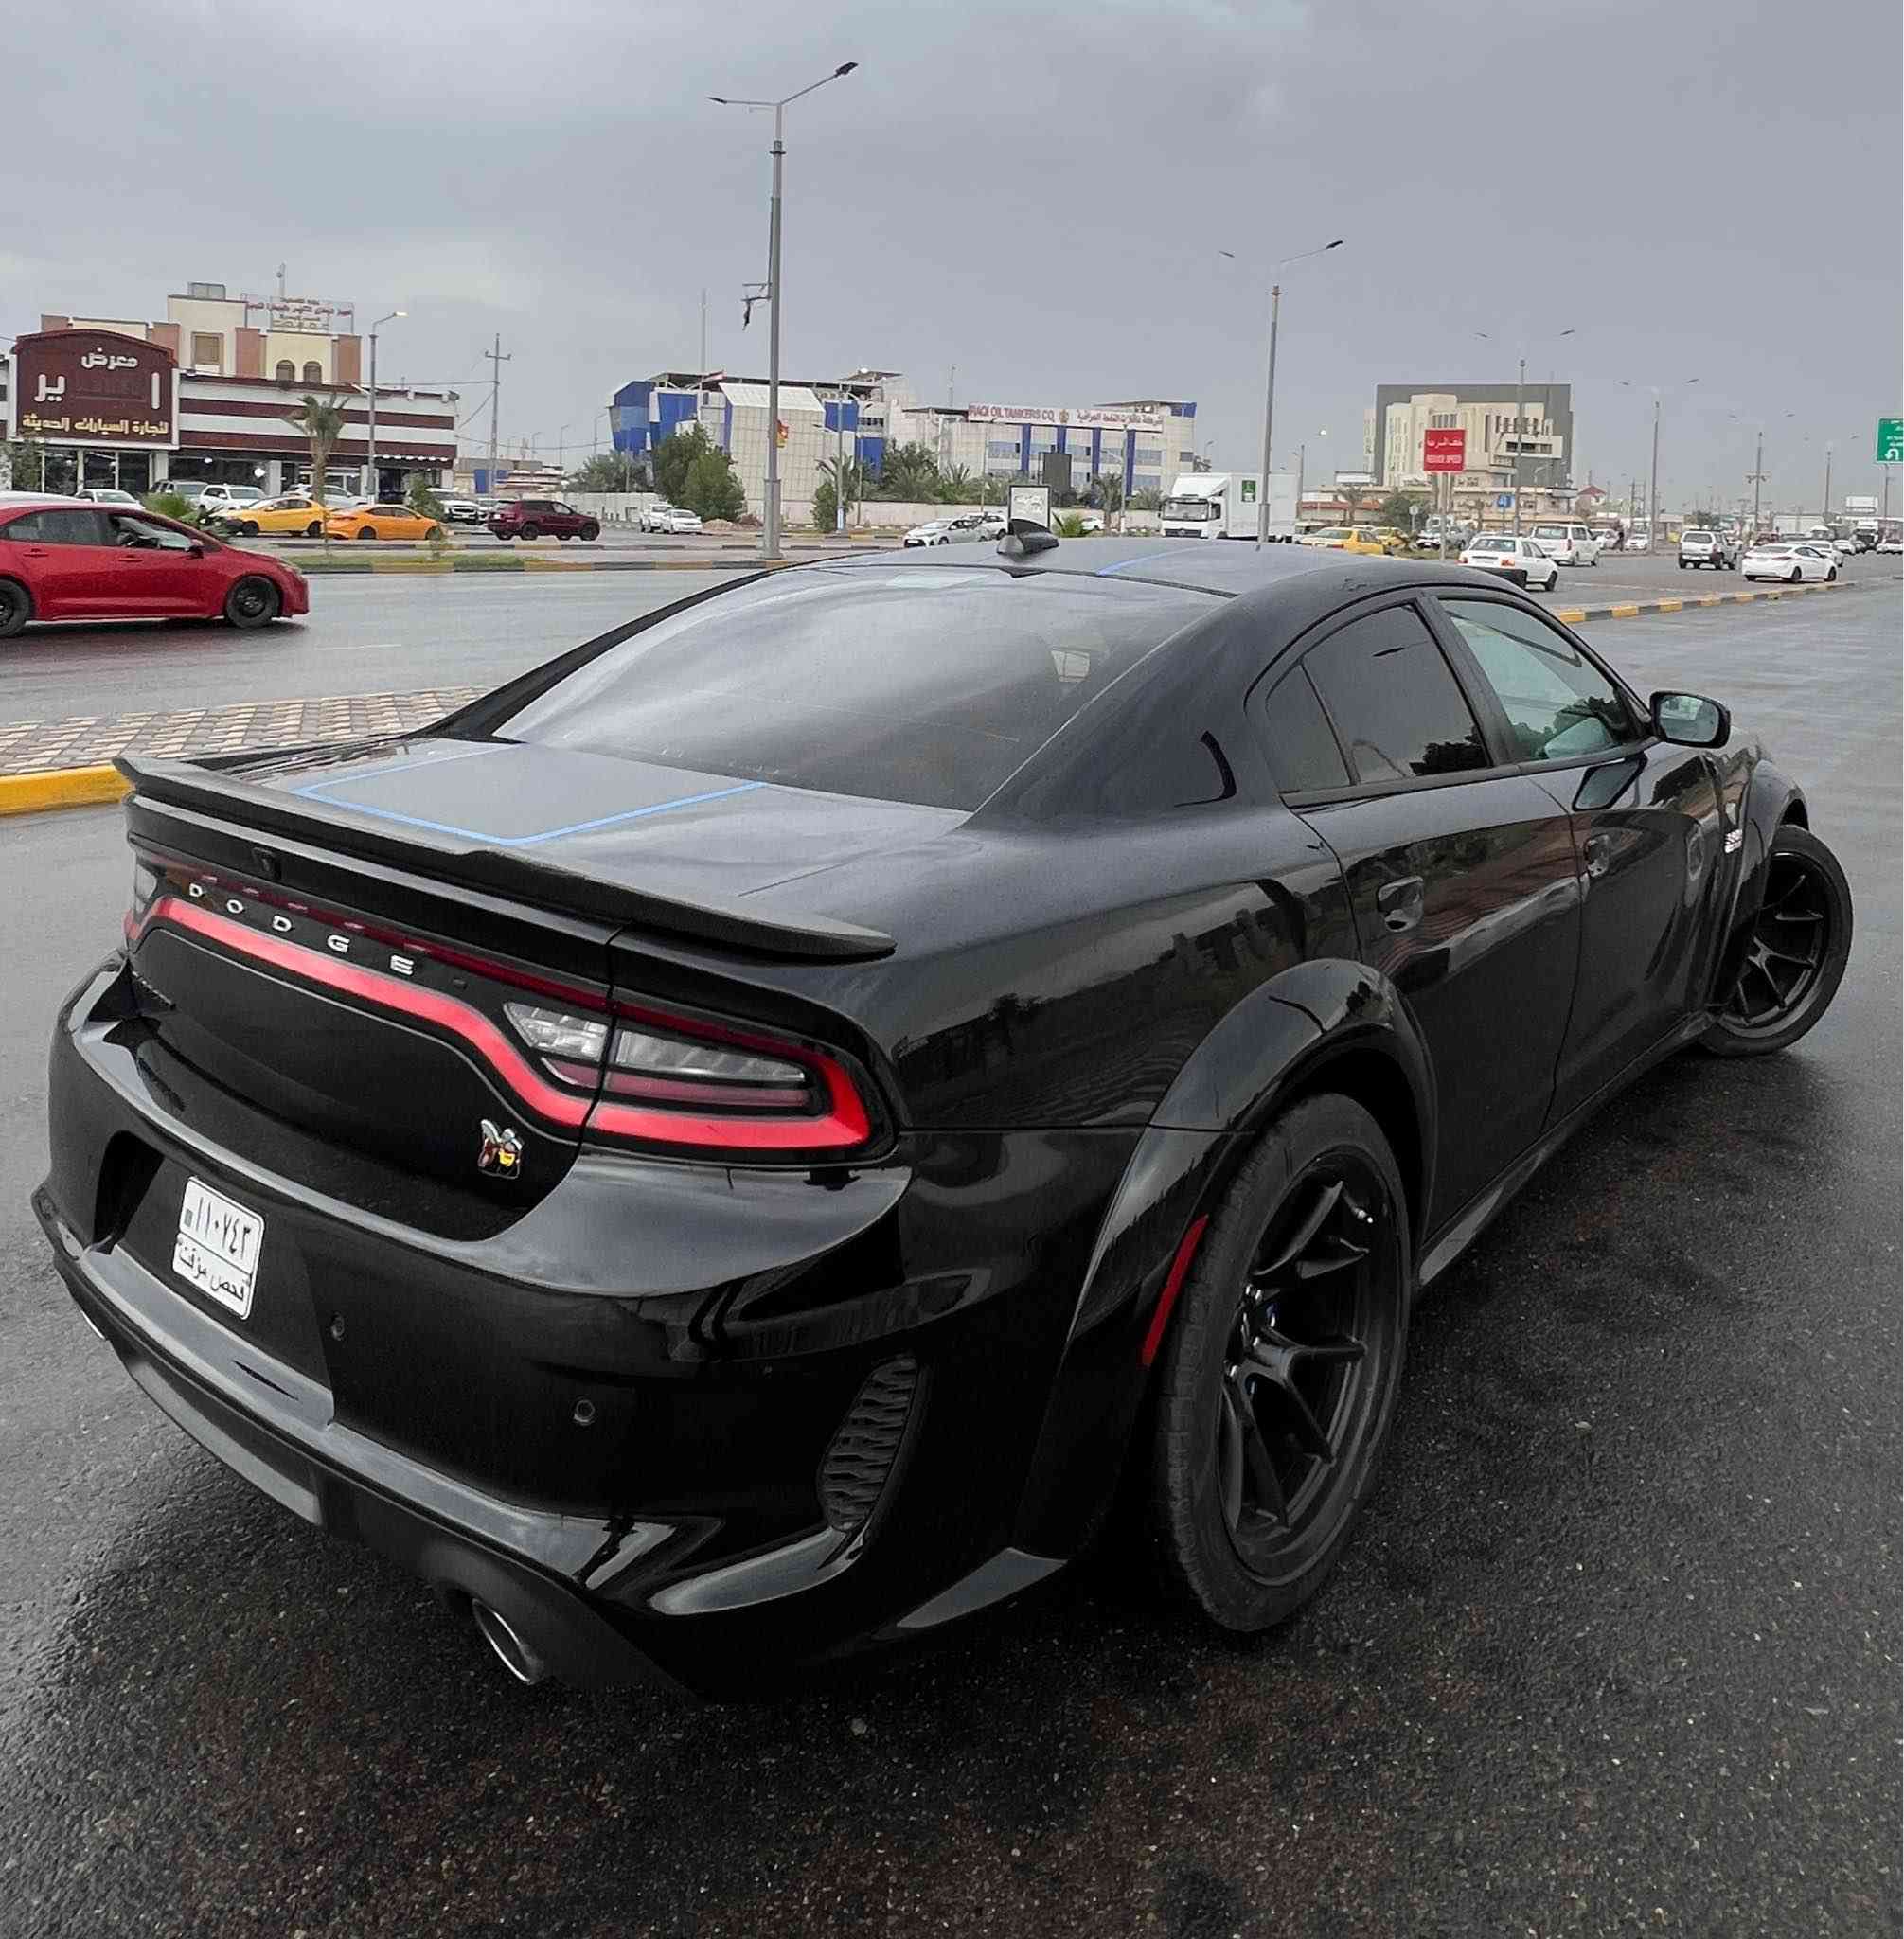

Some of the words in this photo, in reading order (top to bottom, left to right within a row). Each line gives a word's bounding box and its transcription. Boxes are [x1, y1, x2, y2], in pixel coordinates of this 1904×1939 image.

[80, 347, 139, 370] معرض
[22, 413, 71, 433] الحديثة
[74, 418, 130, 436] السيارات
[132, 420, 169, 436] لتجارة
[188, 882, 415, 975] DODGE
